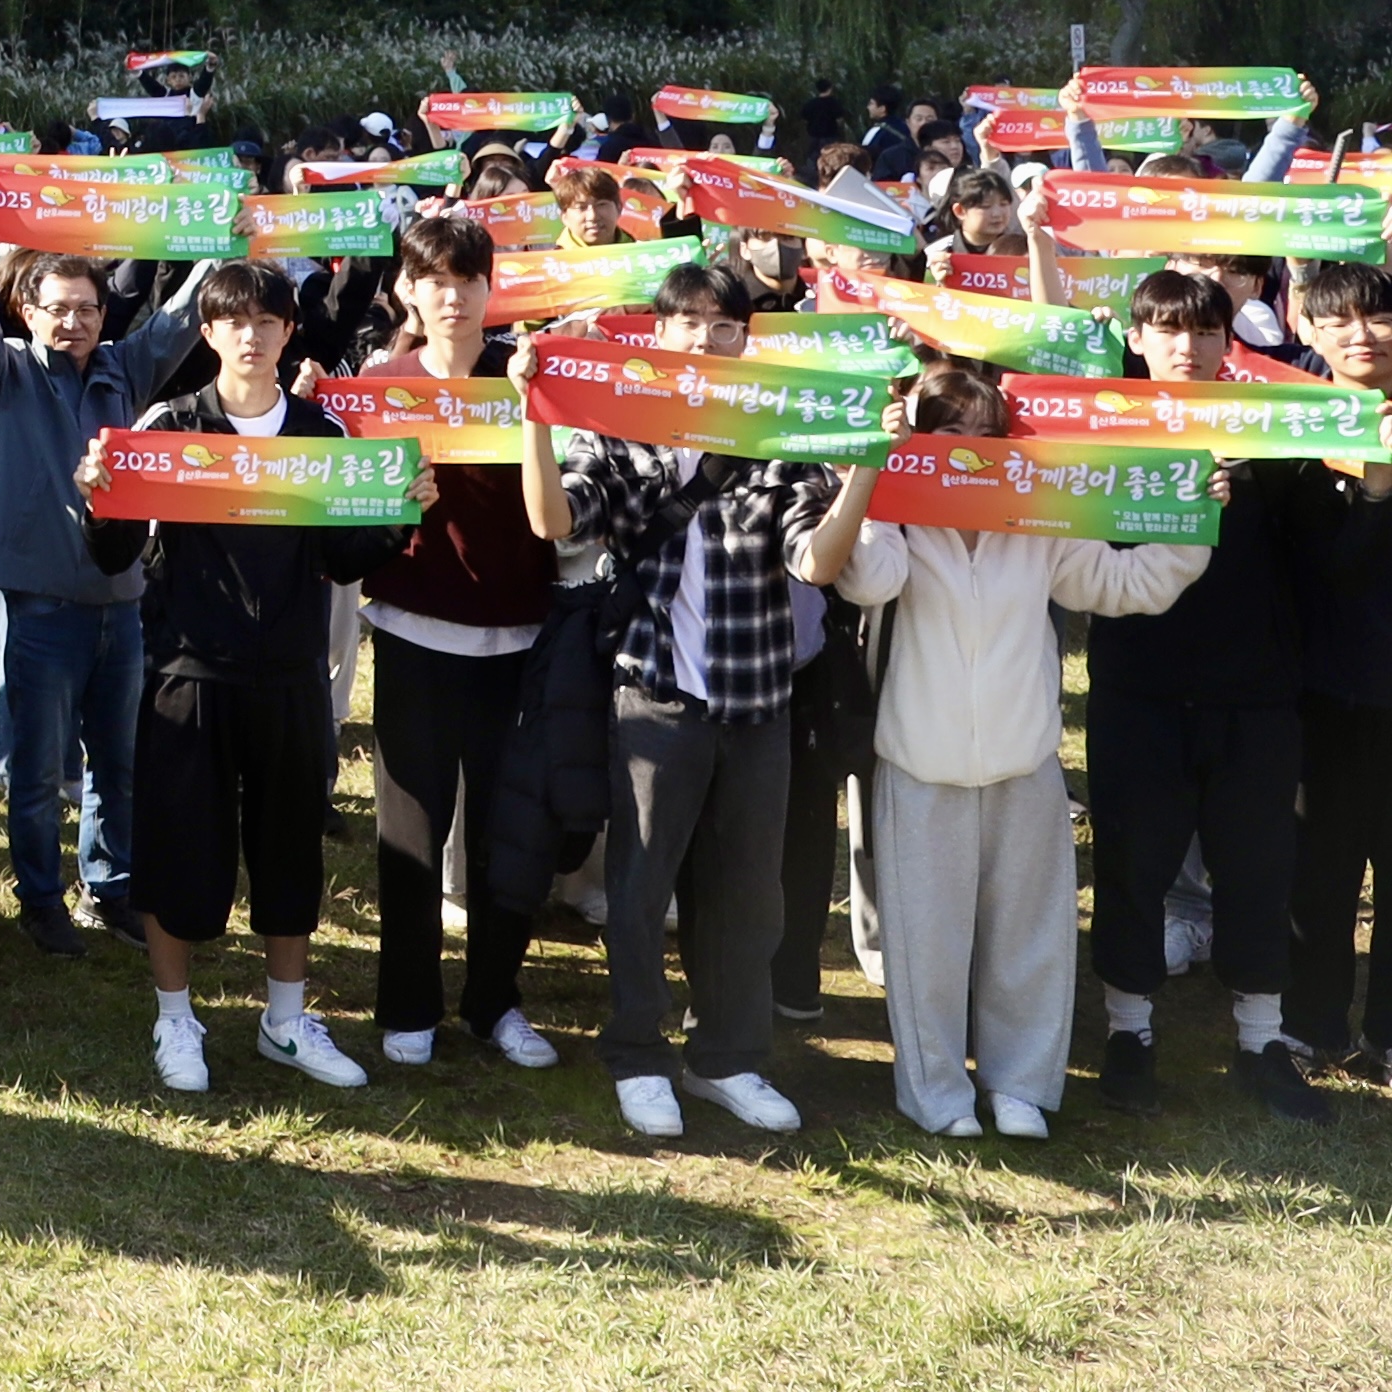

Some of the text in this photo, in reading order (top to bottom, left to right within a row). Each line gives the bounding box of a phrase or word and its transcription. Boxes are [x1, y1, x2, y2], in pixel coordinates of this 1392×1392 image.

[1087, 81, 1128, 94] 2025
[997, 122, 1033, 133] 2025
[690, 170, 733, 189] 2025
[82, 188, 168, 224] 함께걸어
[1057, 188, 1117, 208] 2025
[1177, 188, 1287, 222] 함께걸어
[818, 270, 877, 298] 2025
[961, 272, 1007, 289] 2025
[544, 356, 609, 382] 2025
[676, 363, 787, 415] 함께걸어
[317, 394, 375, 413] 2025
[1016, 397, 1082, 422] 2025
[1150, 392, 1271, 433] 함께걸어
[113, 451, 172, 472] 2025
[231, 445, 332, 485] 함께걸어
[1003, 451, 1116, 496] 함께걸어
